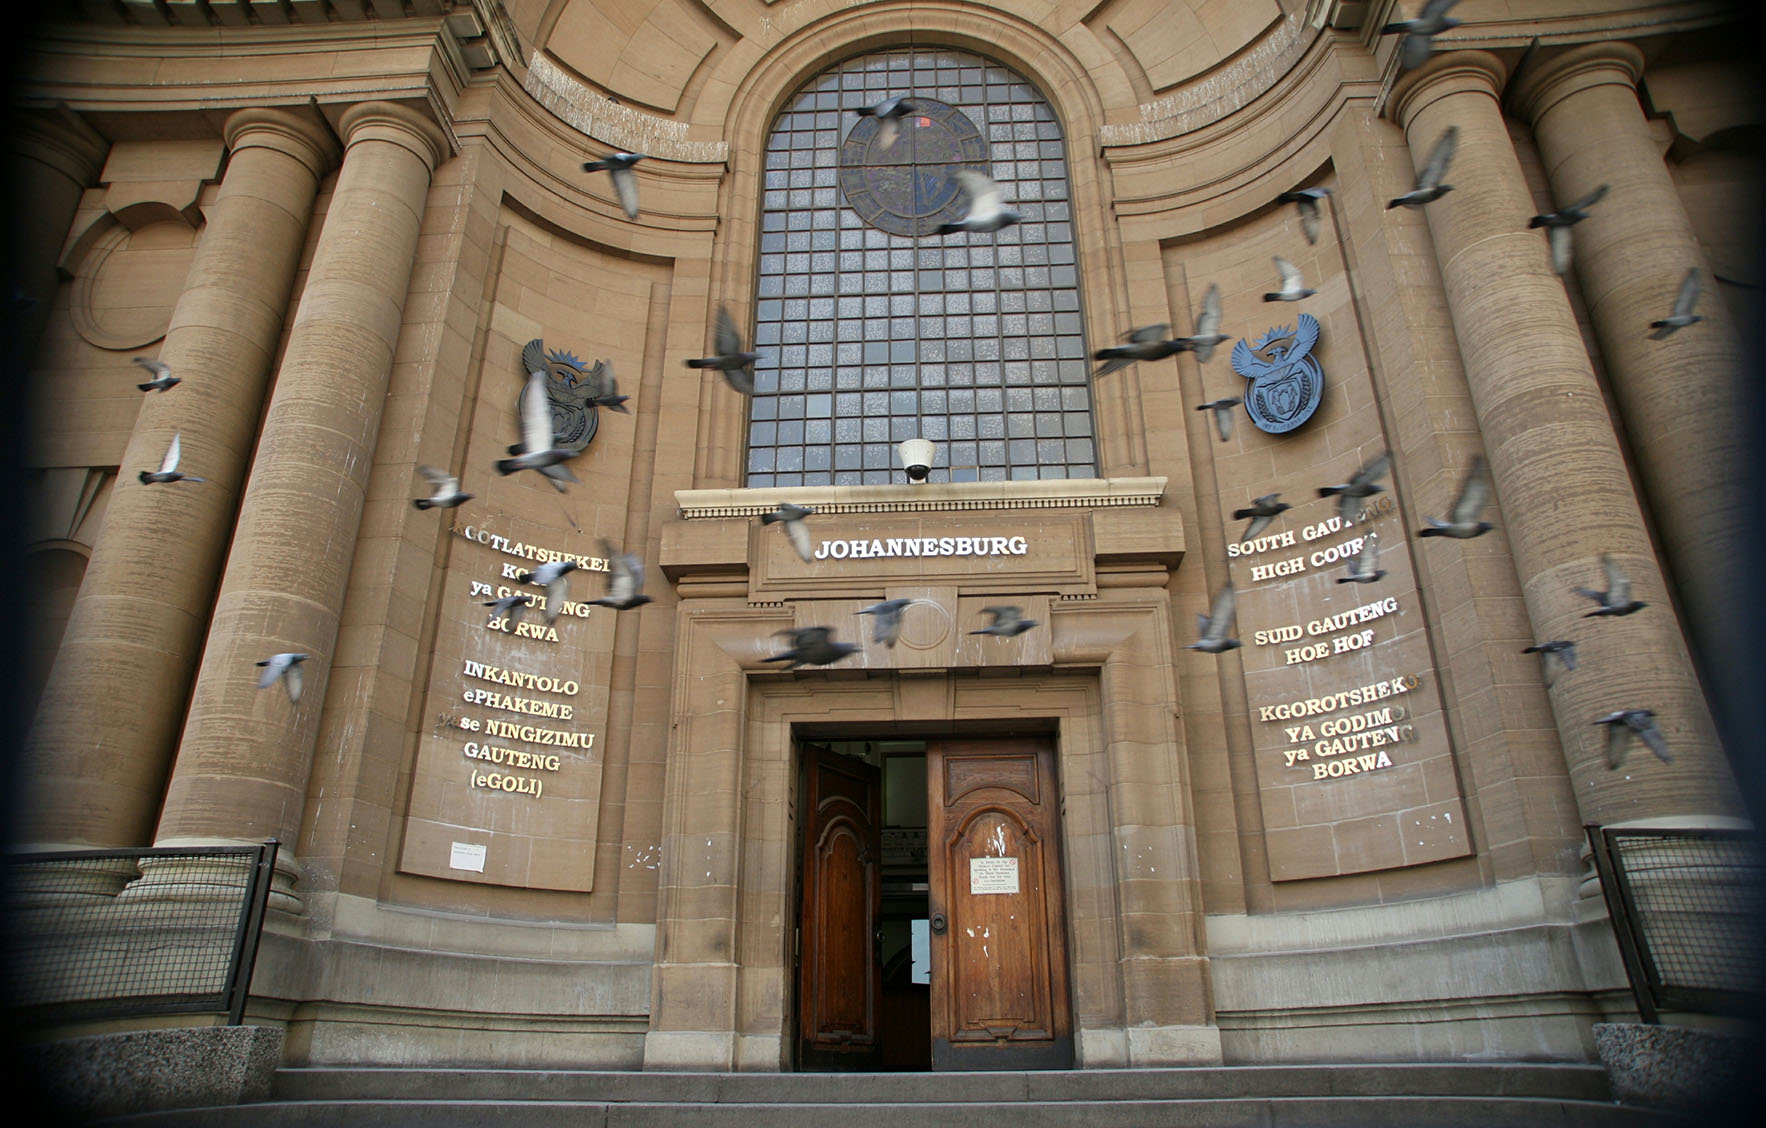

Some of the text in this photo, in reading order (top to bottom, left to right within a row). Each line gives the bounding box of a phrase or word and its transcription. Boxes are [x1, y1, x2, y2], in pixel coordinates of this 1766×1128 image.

[815, 536, 1028, 560] JOHANNESBURG
[1228, 530, 1296, 557] SOUTH
[1250, 557, 1306, 582] HIGH
[470, 581, 492, 596] ya
[1254, 597, 1397, 645] SUID GAUTENG
[1284, 629, 1374, 665] HOE HOF
[463, 659, 579, 695] INKANTOLO
[463, 689, 573, 720] ePHAKEME
[1259, 672, 1419, 722] KGOROTSHEKO
[485, 719, 595, 748] NINGIZIMU
[1285, 704, 1406, 743] YA GODIMO
[464, 742, 561, 771] GAUTENG
[1283, 724, 1414, 766] ya GAUTENG
[1312, 751, 1392, 780] BORWA
[470, 769, 543, 799] (eGOLI)
